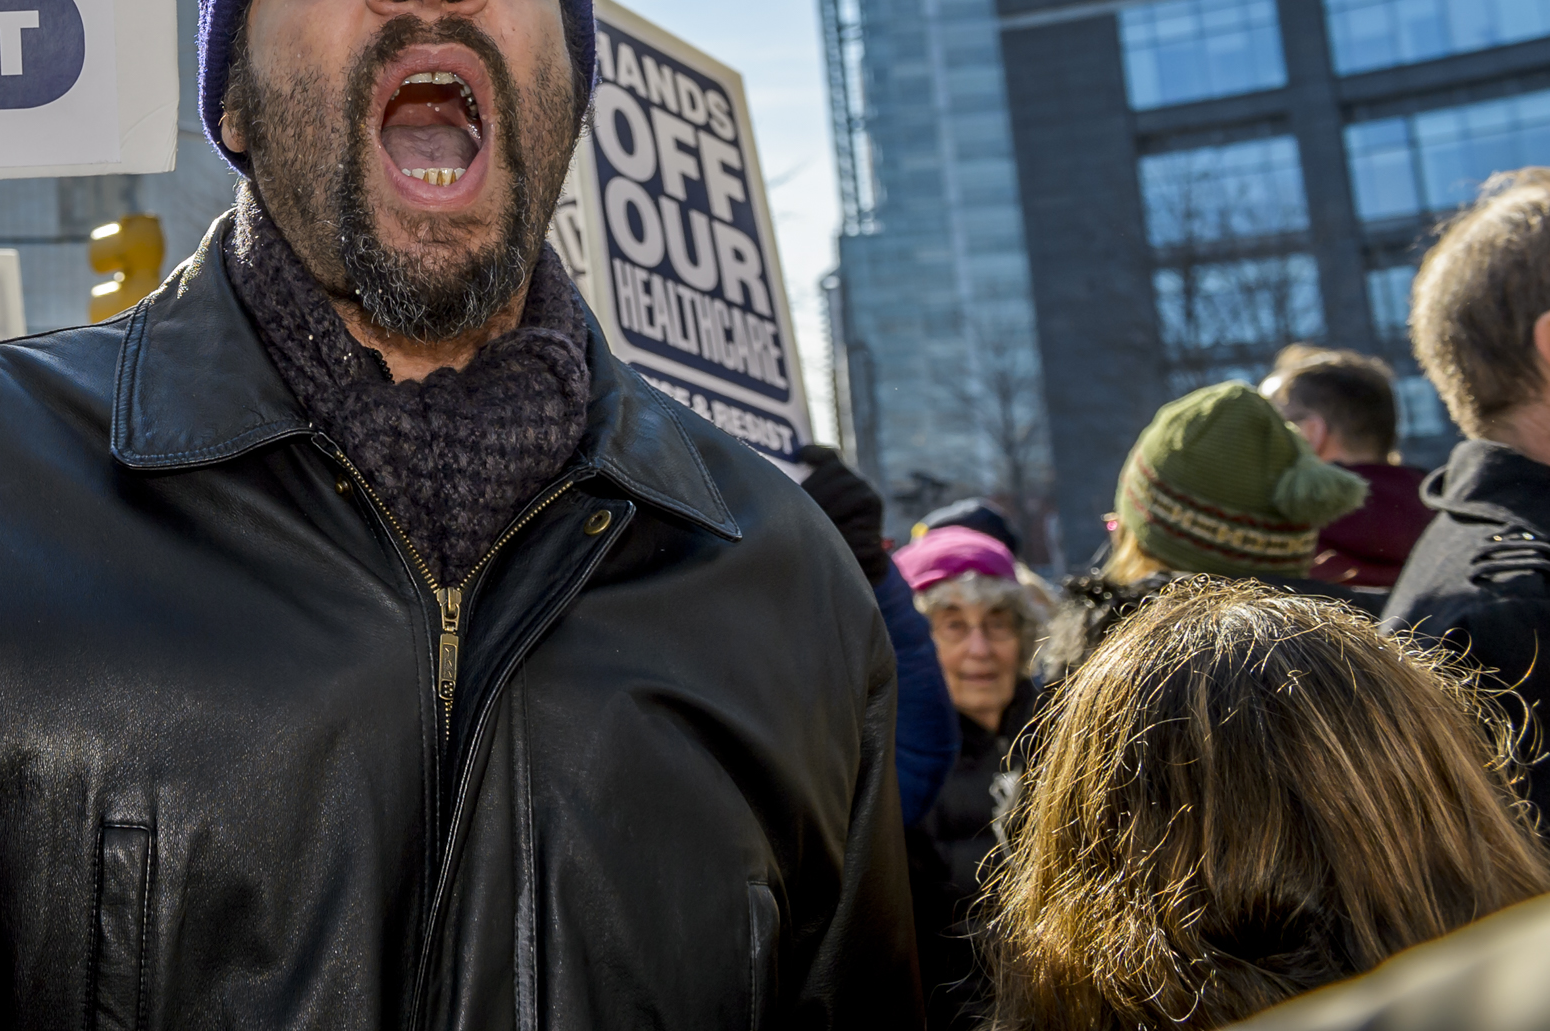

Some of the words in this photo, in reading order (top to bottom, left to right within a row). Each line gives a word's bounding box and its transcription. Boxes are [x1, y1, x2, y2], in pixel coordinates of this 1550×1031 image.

[594, 82, 746, 224] OFF
[604, 176, 771, 319] OUR
[612, 257, 789, 391] HEALTHCARE
[711, 400, 794, 455] RESIST
